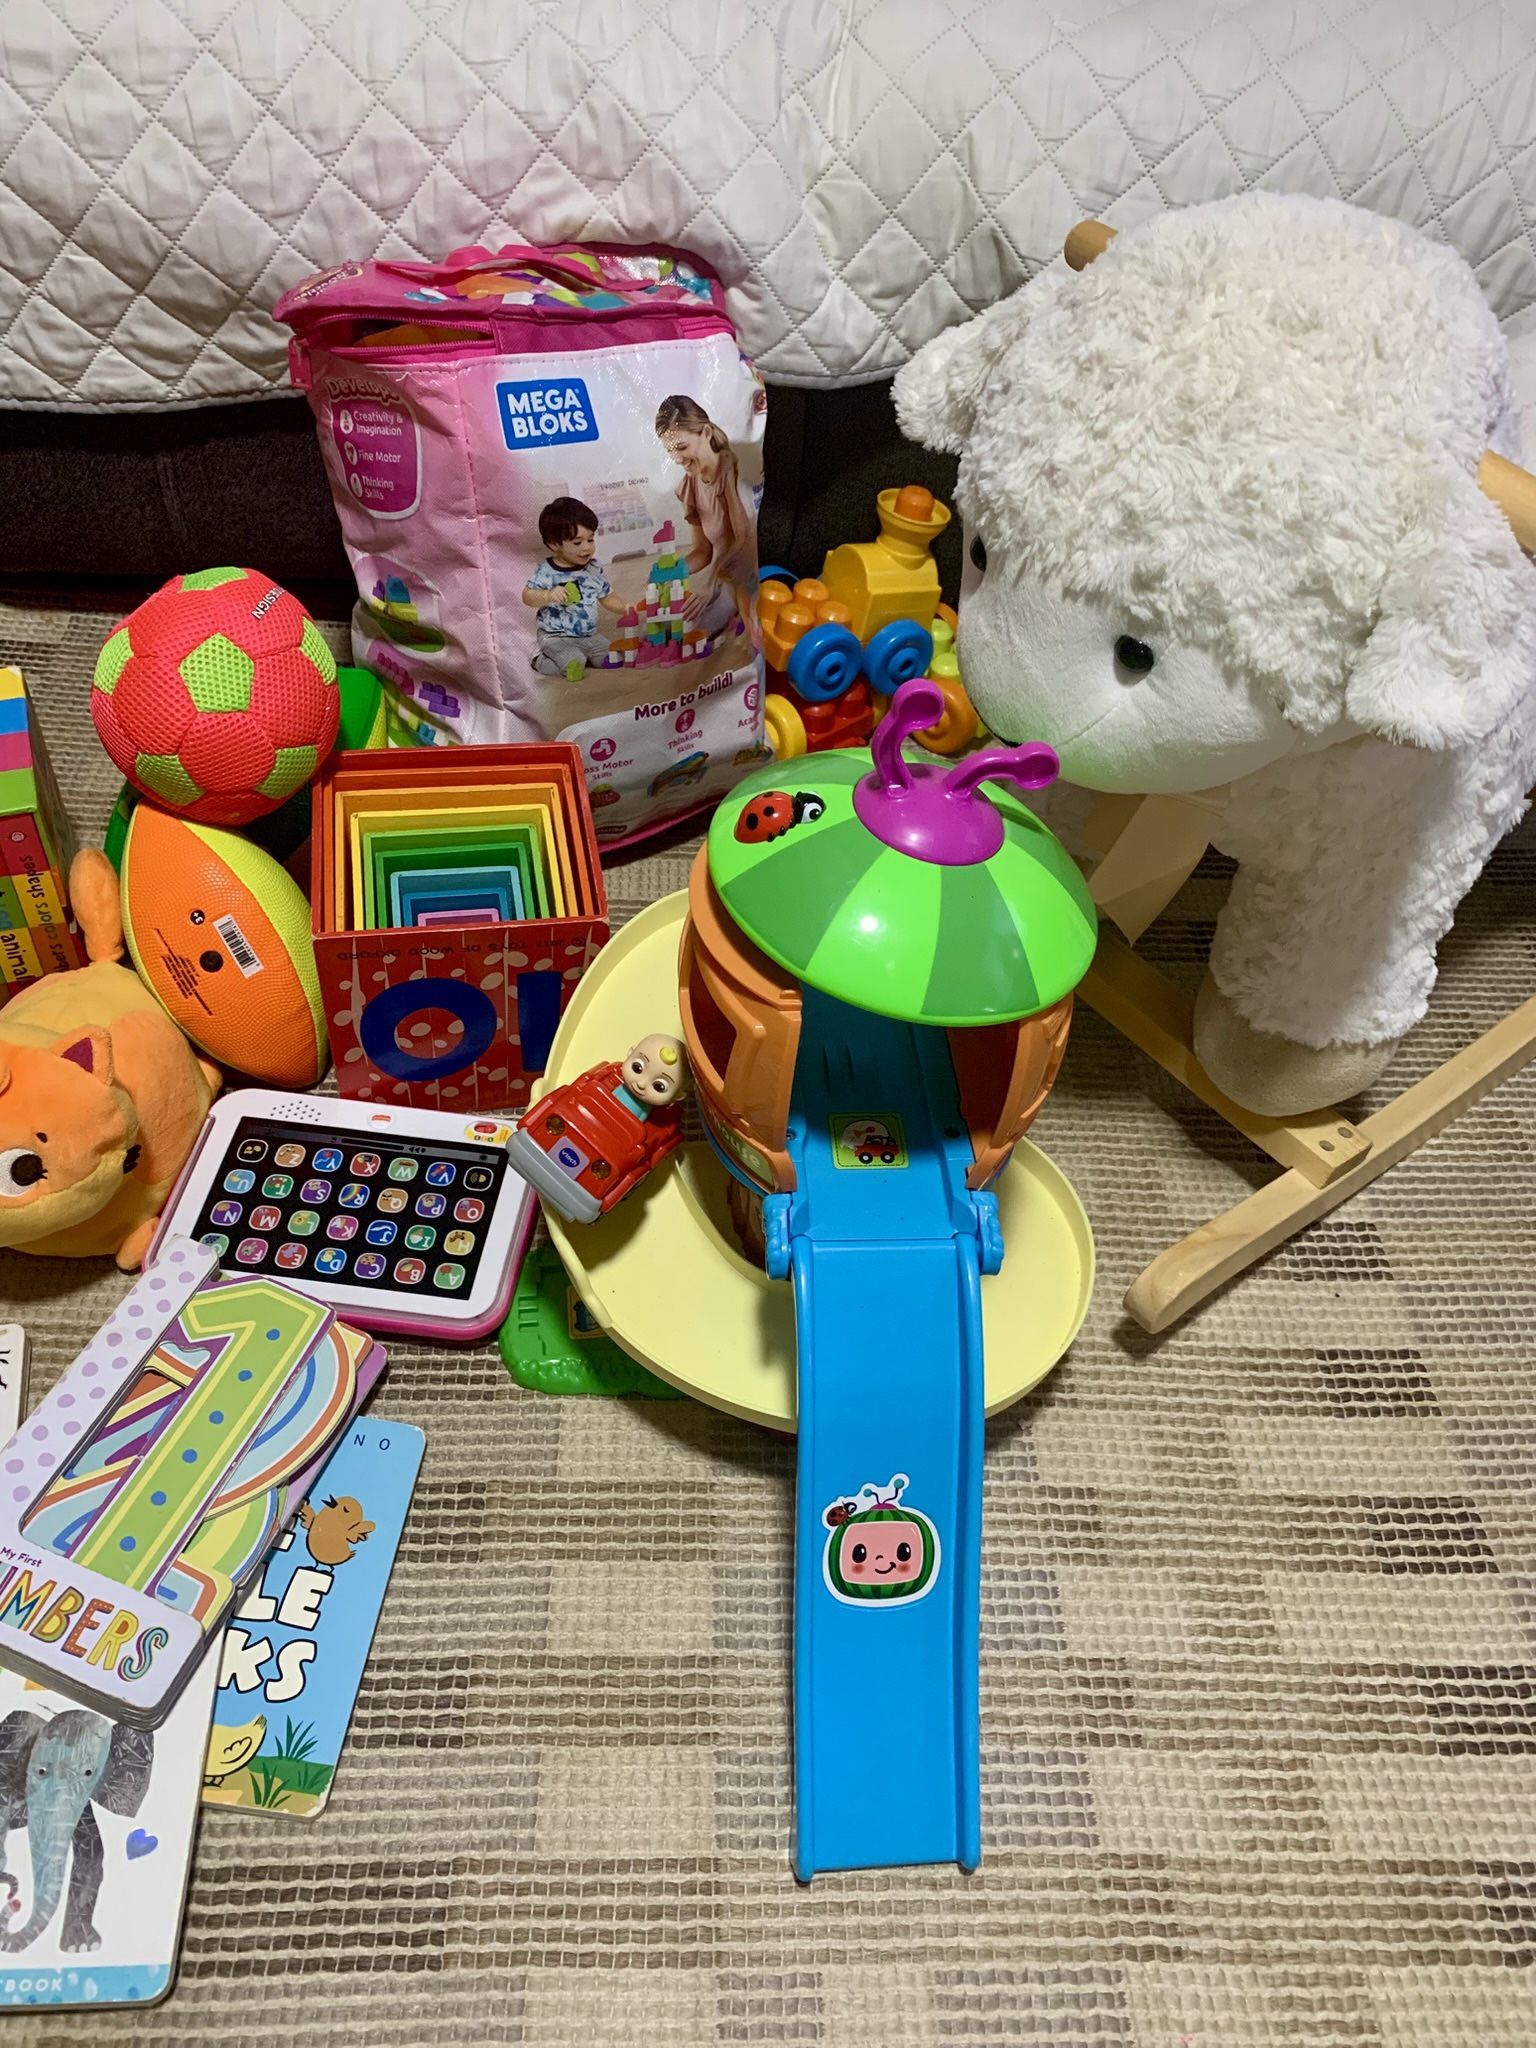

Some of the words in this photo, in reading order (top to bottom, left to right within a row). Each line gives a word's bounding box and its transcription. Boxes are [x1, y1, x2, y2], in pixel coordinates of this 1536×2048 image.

[327, 379, 401, 402] Develop
[507, 388, 581, 415] MEGA
[353, 410, 394, 425] Creativity
[356, 424, 402, 437] Imagination
[511, 411, 588, 439] BLOKS
[359, 449, 374, 461] Fine
[376, 452, 401, 463] Motor
[362, 475, 394, 491] Thinking
[364, 488, 384, 500] Skills
[634, 701, 676, 721] More
[680, 692, 695, 707] to
[698, 672, 733, 699] build!
[667, 729, 703, 750] Thinking
[584, 766, 600, 775] oss
[603, 758, 633, 771] Motor
[592, 771, 612, 782] Skills
[19, 856, 45, 898] shapes
[35, 902, 58, 939] colors
[408, 946, 453, 955] WOOD
[462, 944, 480, 952] OF
[488, 943, 527, 951] TOYS
[50, 943, 70, 972] bers
[337, 949, 400, 960] OXFORD
[289, 1153, 300, 1165] Z
[326, 1160, 336, 1169] Y
[364, 1162, 376, 1174] X
[395, 1167, 411, 1178] W
[438, 1173, 449, 1184] V
[237, 1180, 249, 1190] U
[275, 1185, 287, 1196] T
[315, 1189, 327, 1200] S
[354, 1194, 365, 1205] R
[431, 1204, 442, 1215] P
[467, 1208, 479, 1219] O
[223, 1211, 237, 1222] N
[260, 1215, 276, 1228] M
[307, 1221, 316, 1233] L
[341, 1225, 354, 1238] K
[379, 1231, 392, 1242] J
[421, 1236, 432, 1248] I
[252, 1250, 264, 1261] F
[291, 1253, 303, 1266] E
[330, 1259, 341, 1271] D
[368, 1264, 381, 1275] C
[410, 1269, 421, 1281] B
[449, 1273, 461, 1285] A
[1, 1547, 16, 1560] My
[17, 1553, 43, 1568] First
[217, 1626, 318, 1704] KS
[0, 1977, 63, 1993] BOOK
